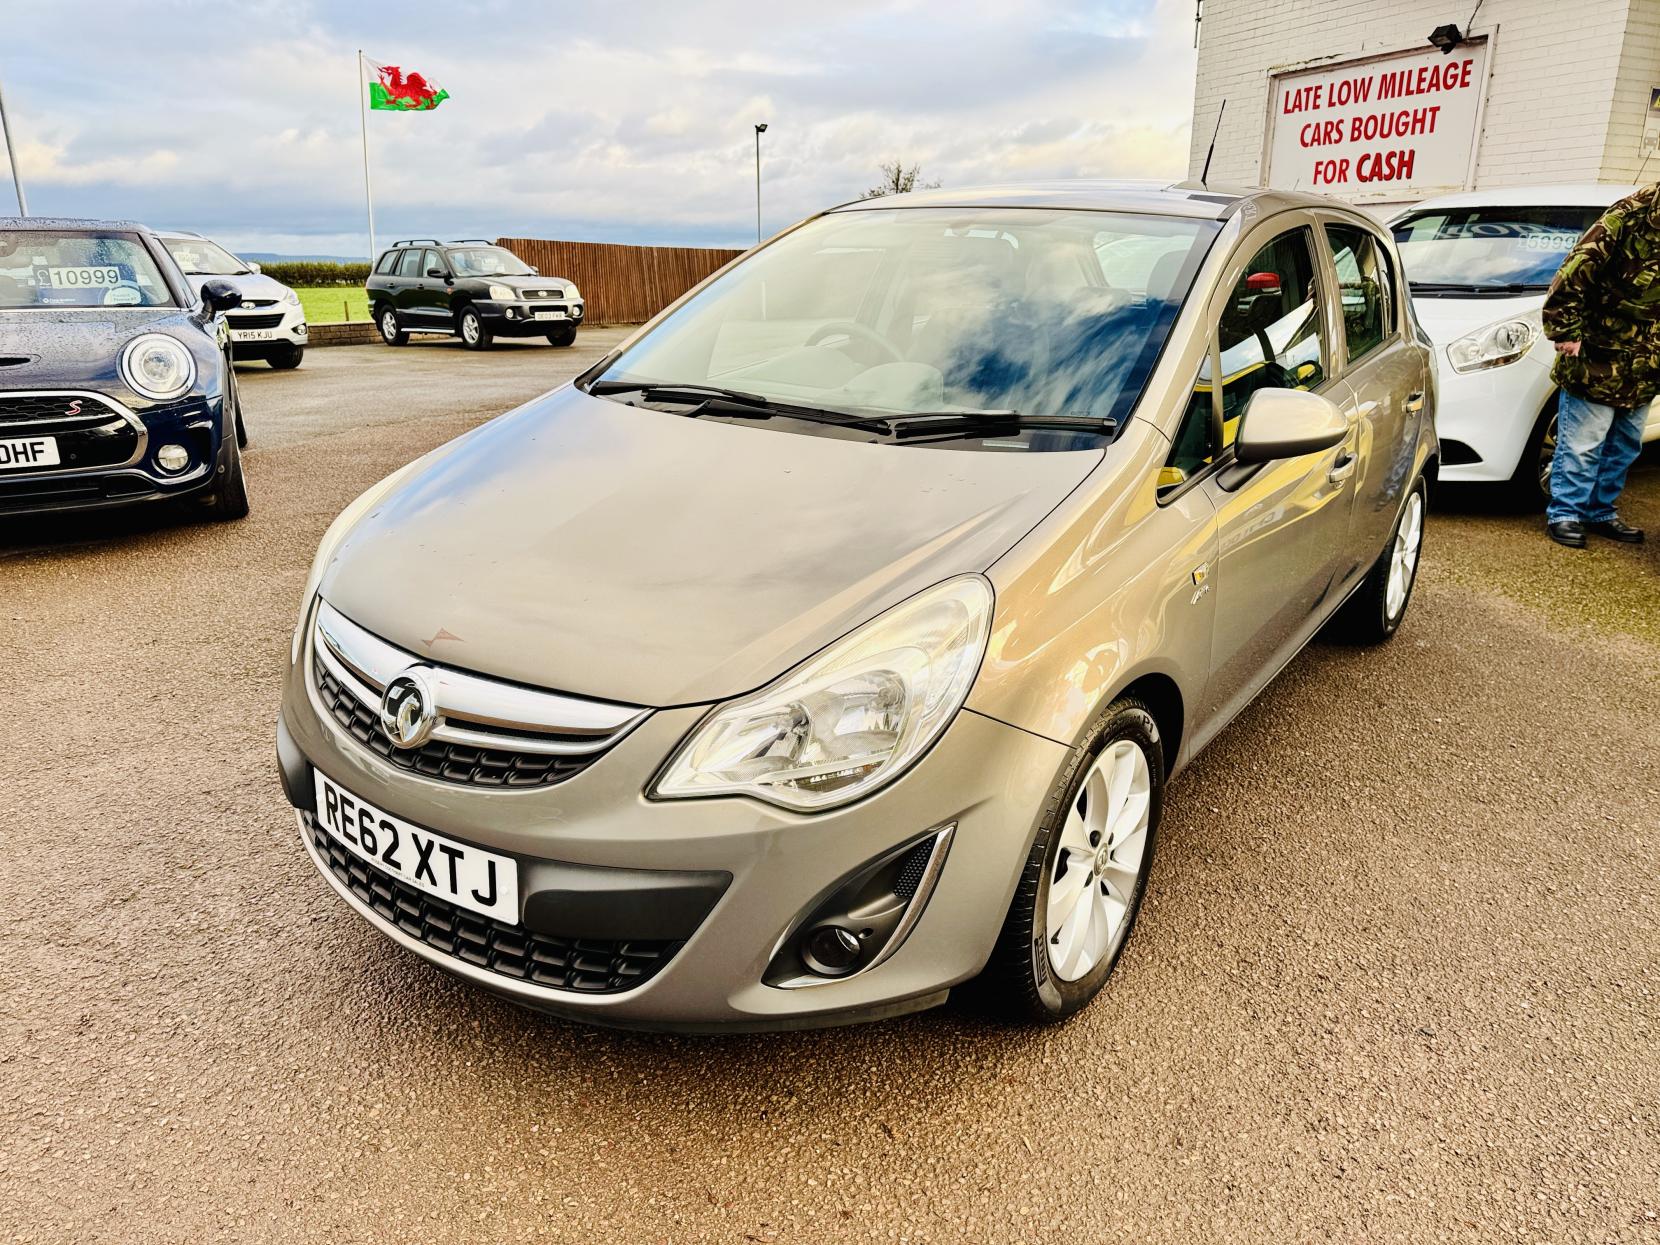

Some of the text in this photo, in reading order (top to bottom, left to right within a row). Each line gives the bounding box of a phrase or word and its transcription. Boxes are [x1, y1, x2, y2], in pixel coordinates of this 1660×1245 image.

[1283, 58, 1474, 115] LATE LOW MILEAGE
[1299, 105, 1441, 148] CARS BOUGHT
[1312, 149, 1415, 185] FOR CASH
[323, 780, 498, 907] RE62 XTJ
